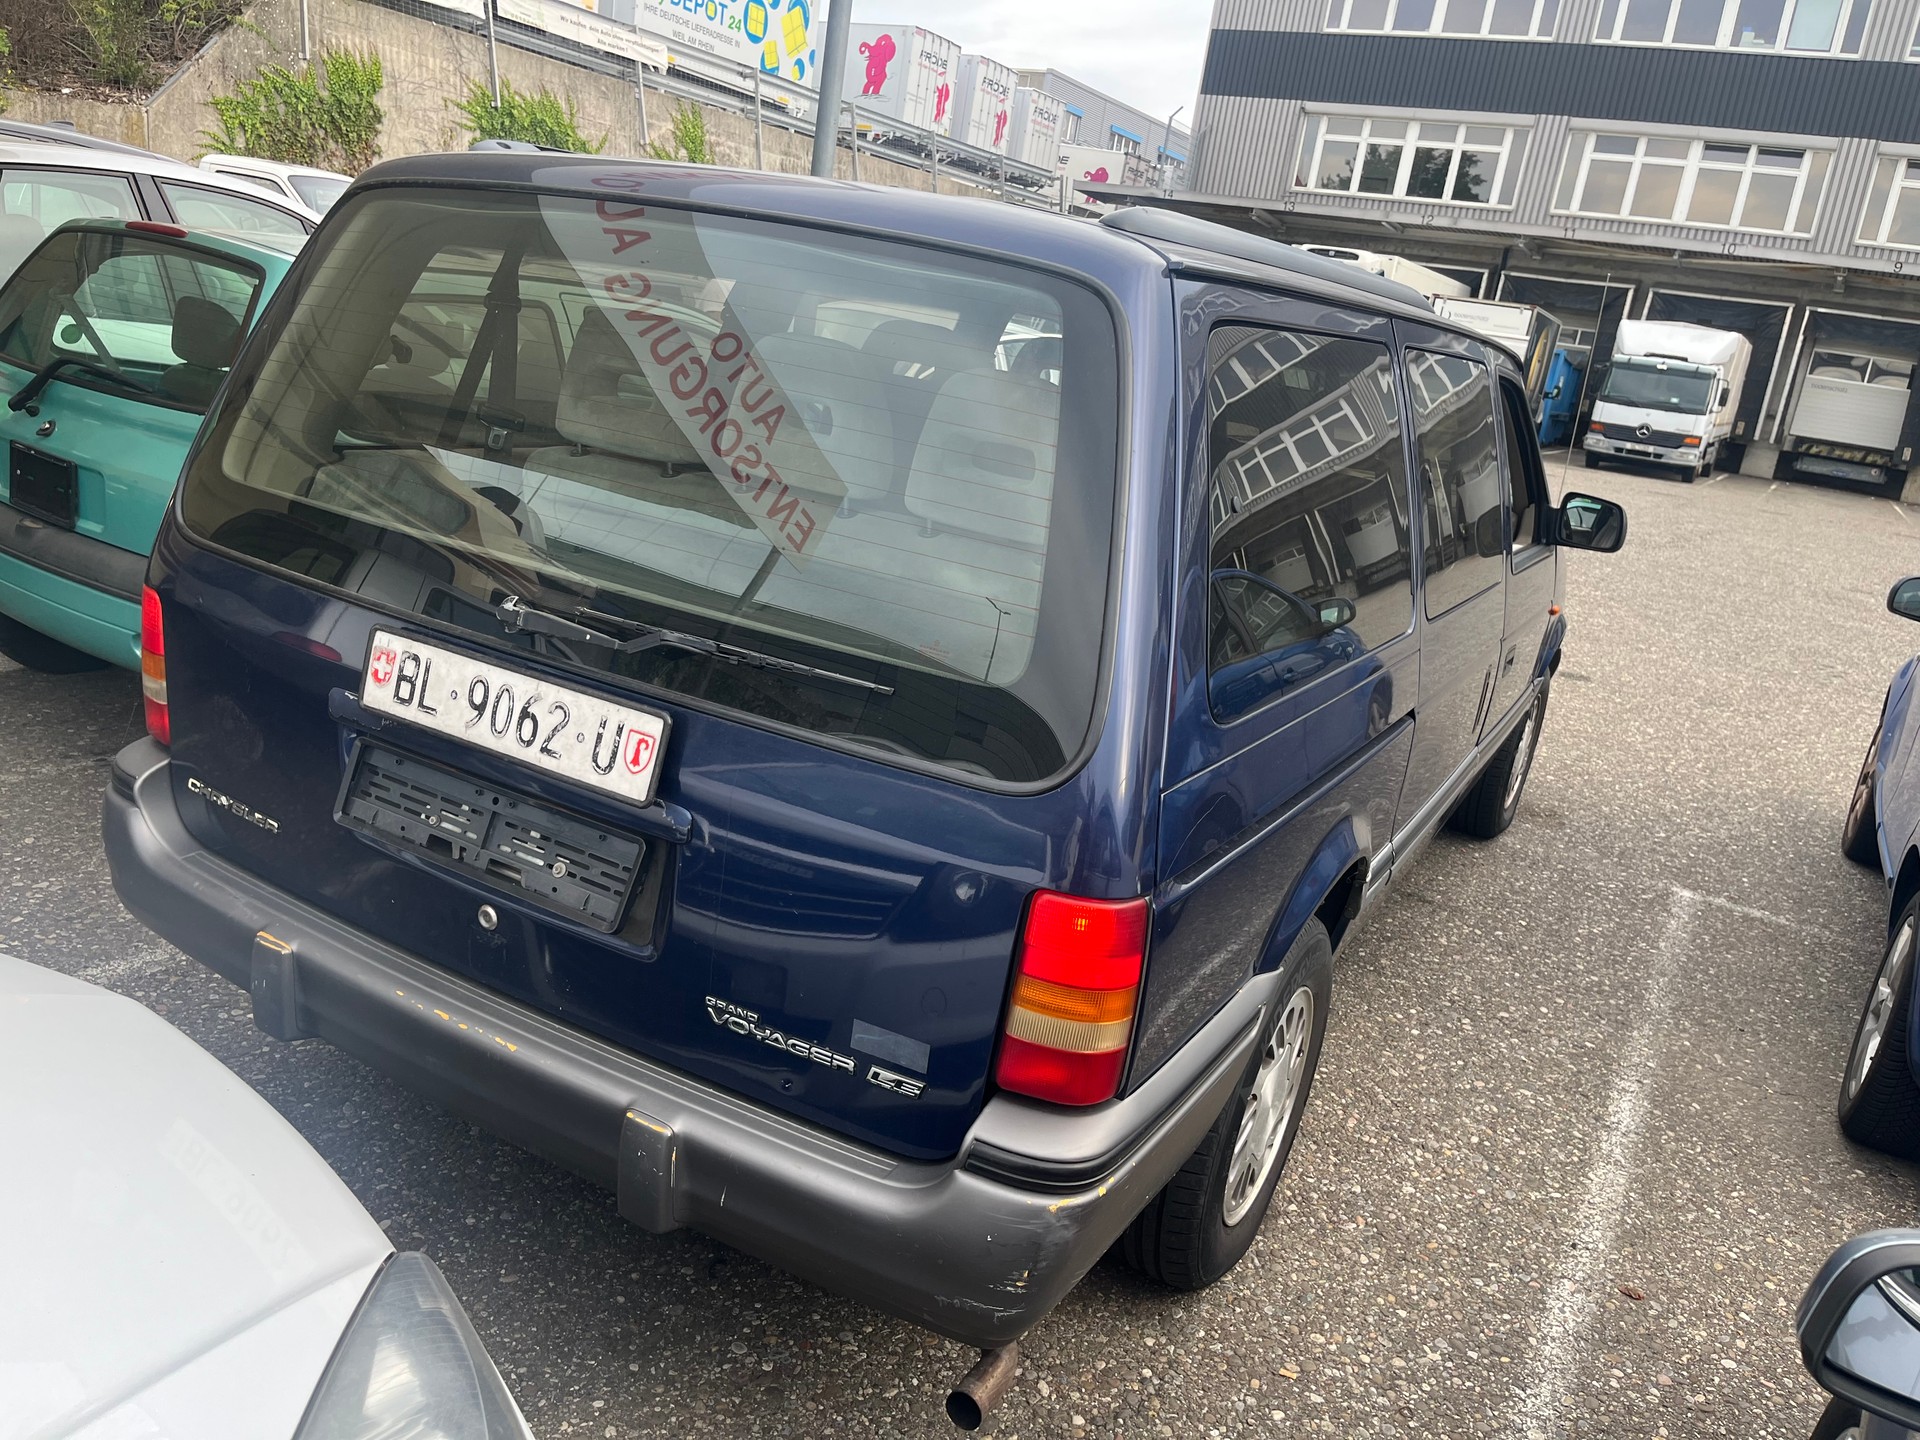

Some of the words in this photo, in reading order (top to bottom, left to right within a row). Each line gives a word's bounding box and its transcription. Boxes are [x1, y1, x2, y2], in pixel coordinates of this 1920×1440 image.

[644, 3, 658, 16] IHRE
[660, 9, 690, 29] DEUTSCHE
[691, 21, 734, 46] LIEFERADRESSE
[728, 15, 742, 32] 24
[672, 29, 686, 42] WEIL
[688, 36, 697, 46] AM
[698, 39, 715, 53] RHEIN
[1163, 189, 1173, 199] 14
[1283, 201, 1295, 213] 13
[1421, 215, 1434, 226] 12
[1564, 227, 1576, 239] 11
[1722, 242, 1737, 256] 10
[1893, 261, 1903, 273] 9
[464, 674, 571, 760] 9062
[705, 995, 760, 1022] GRAND
[706, 1006, 857, 1076] VOYAGER
